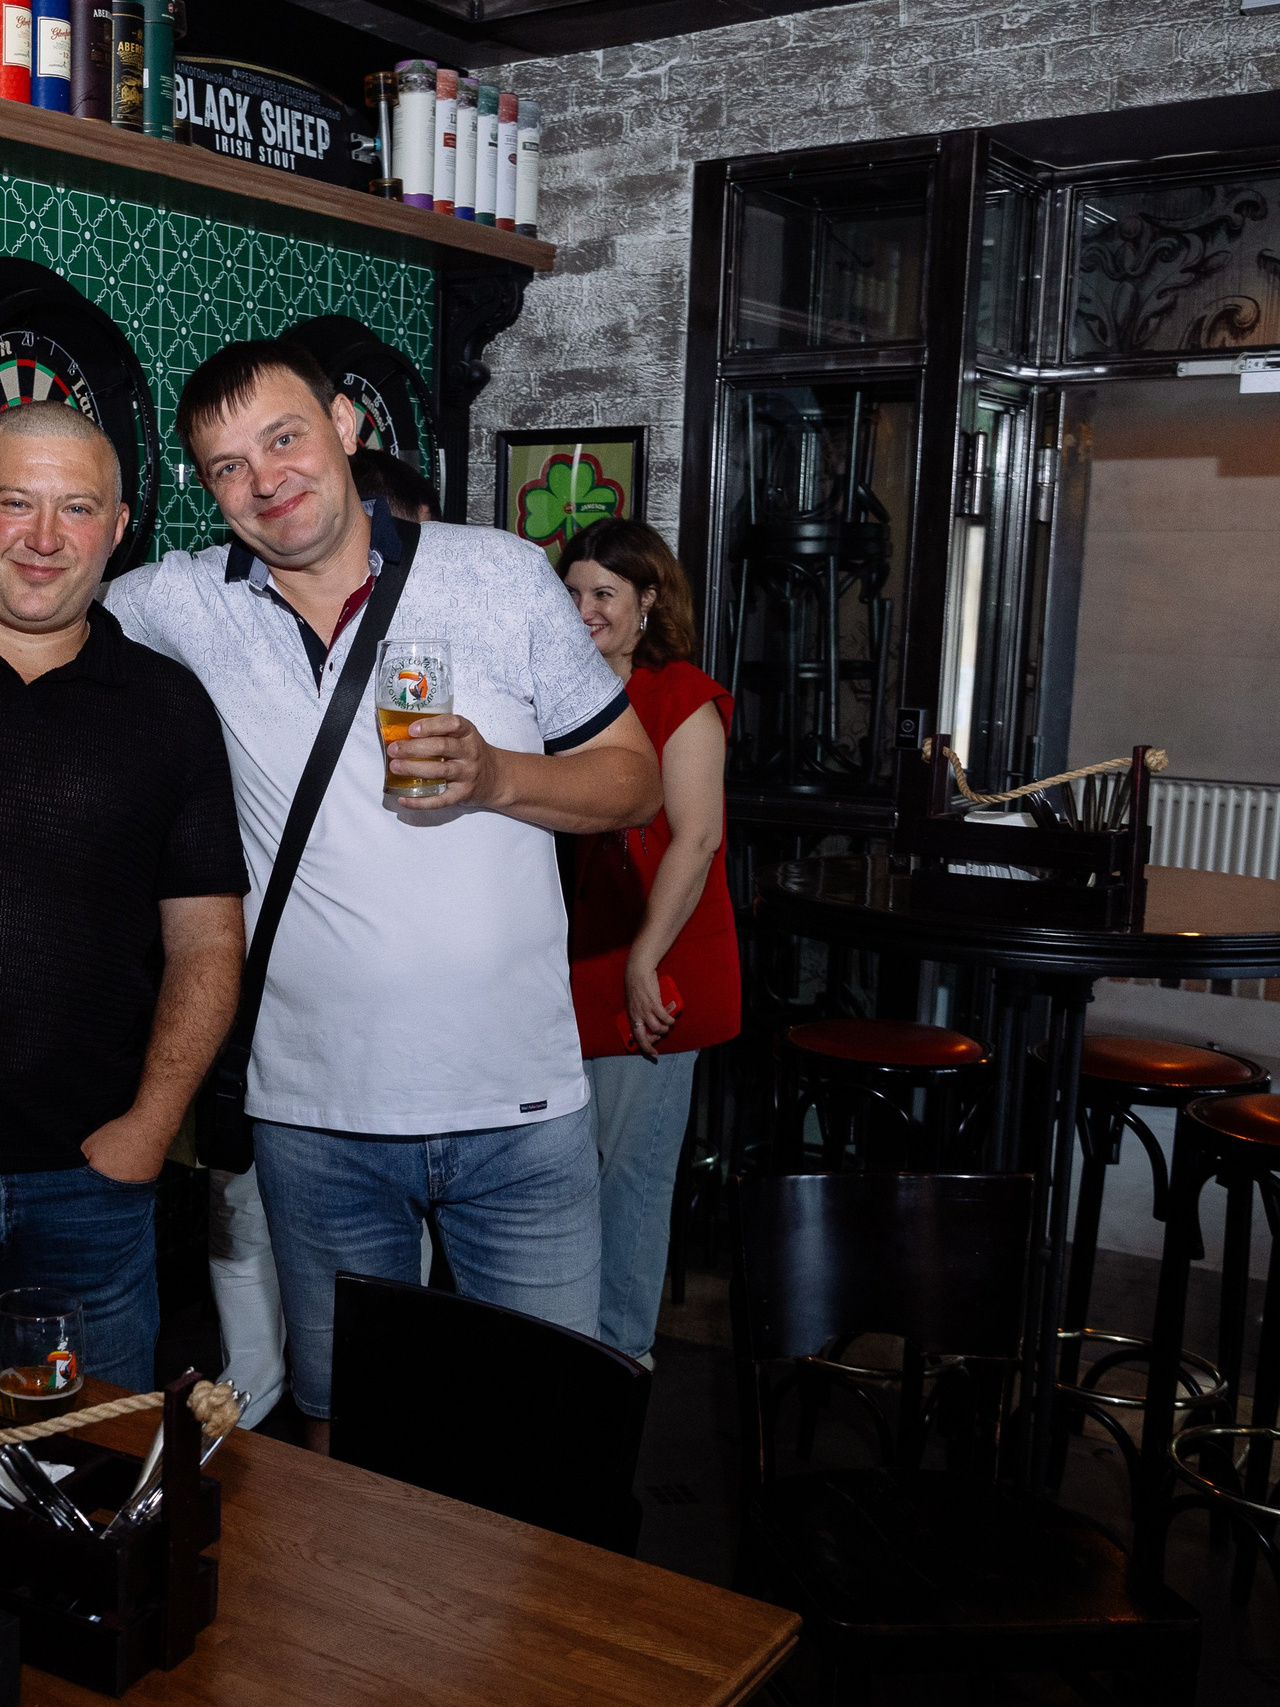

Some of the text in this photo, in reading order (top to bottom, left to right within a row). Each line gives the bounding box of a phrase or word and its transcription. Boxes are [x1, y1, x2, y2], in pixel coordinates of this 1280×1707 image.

[174, 73, 254, 141] BLACK
[260, 100, 331, 160] SHEEP
[215, 133, 296, 171] IRISH STOUT
[21, 331, 35, 347] 20
